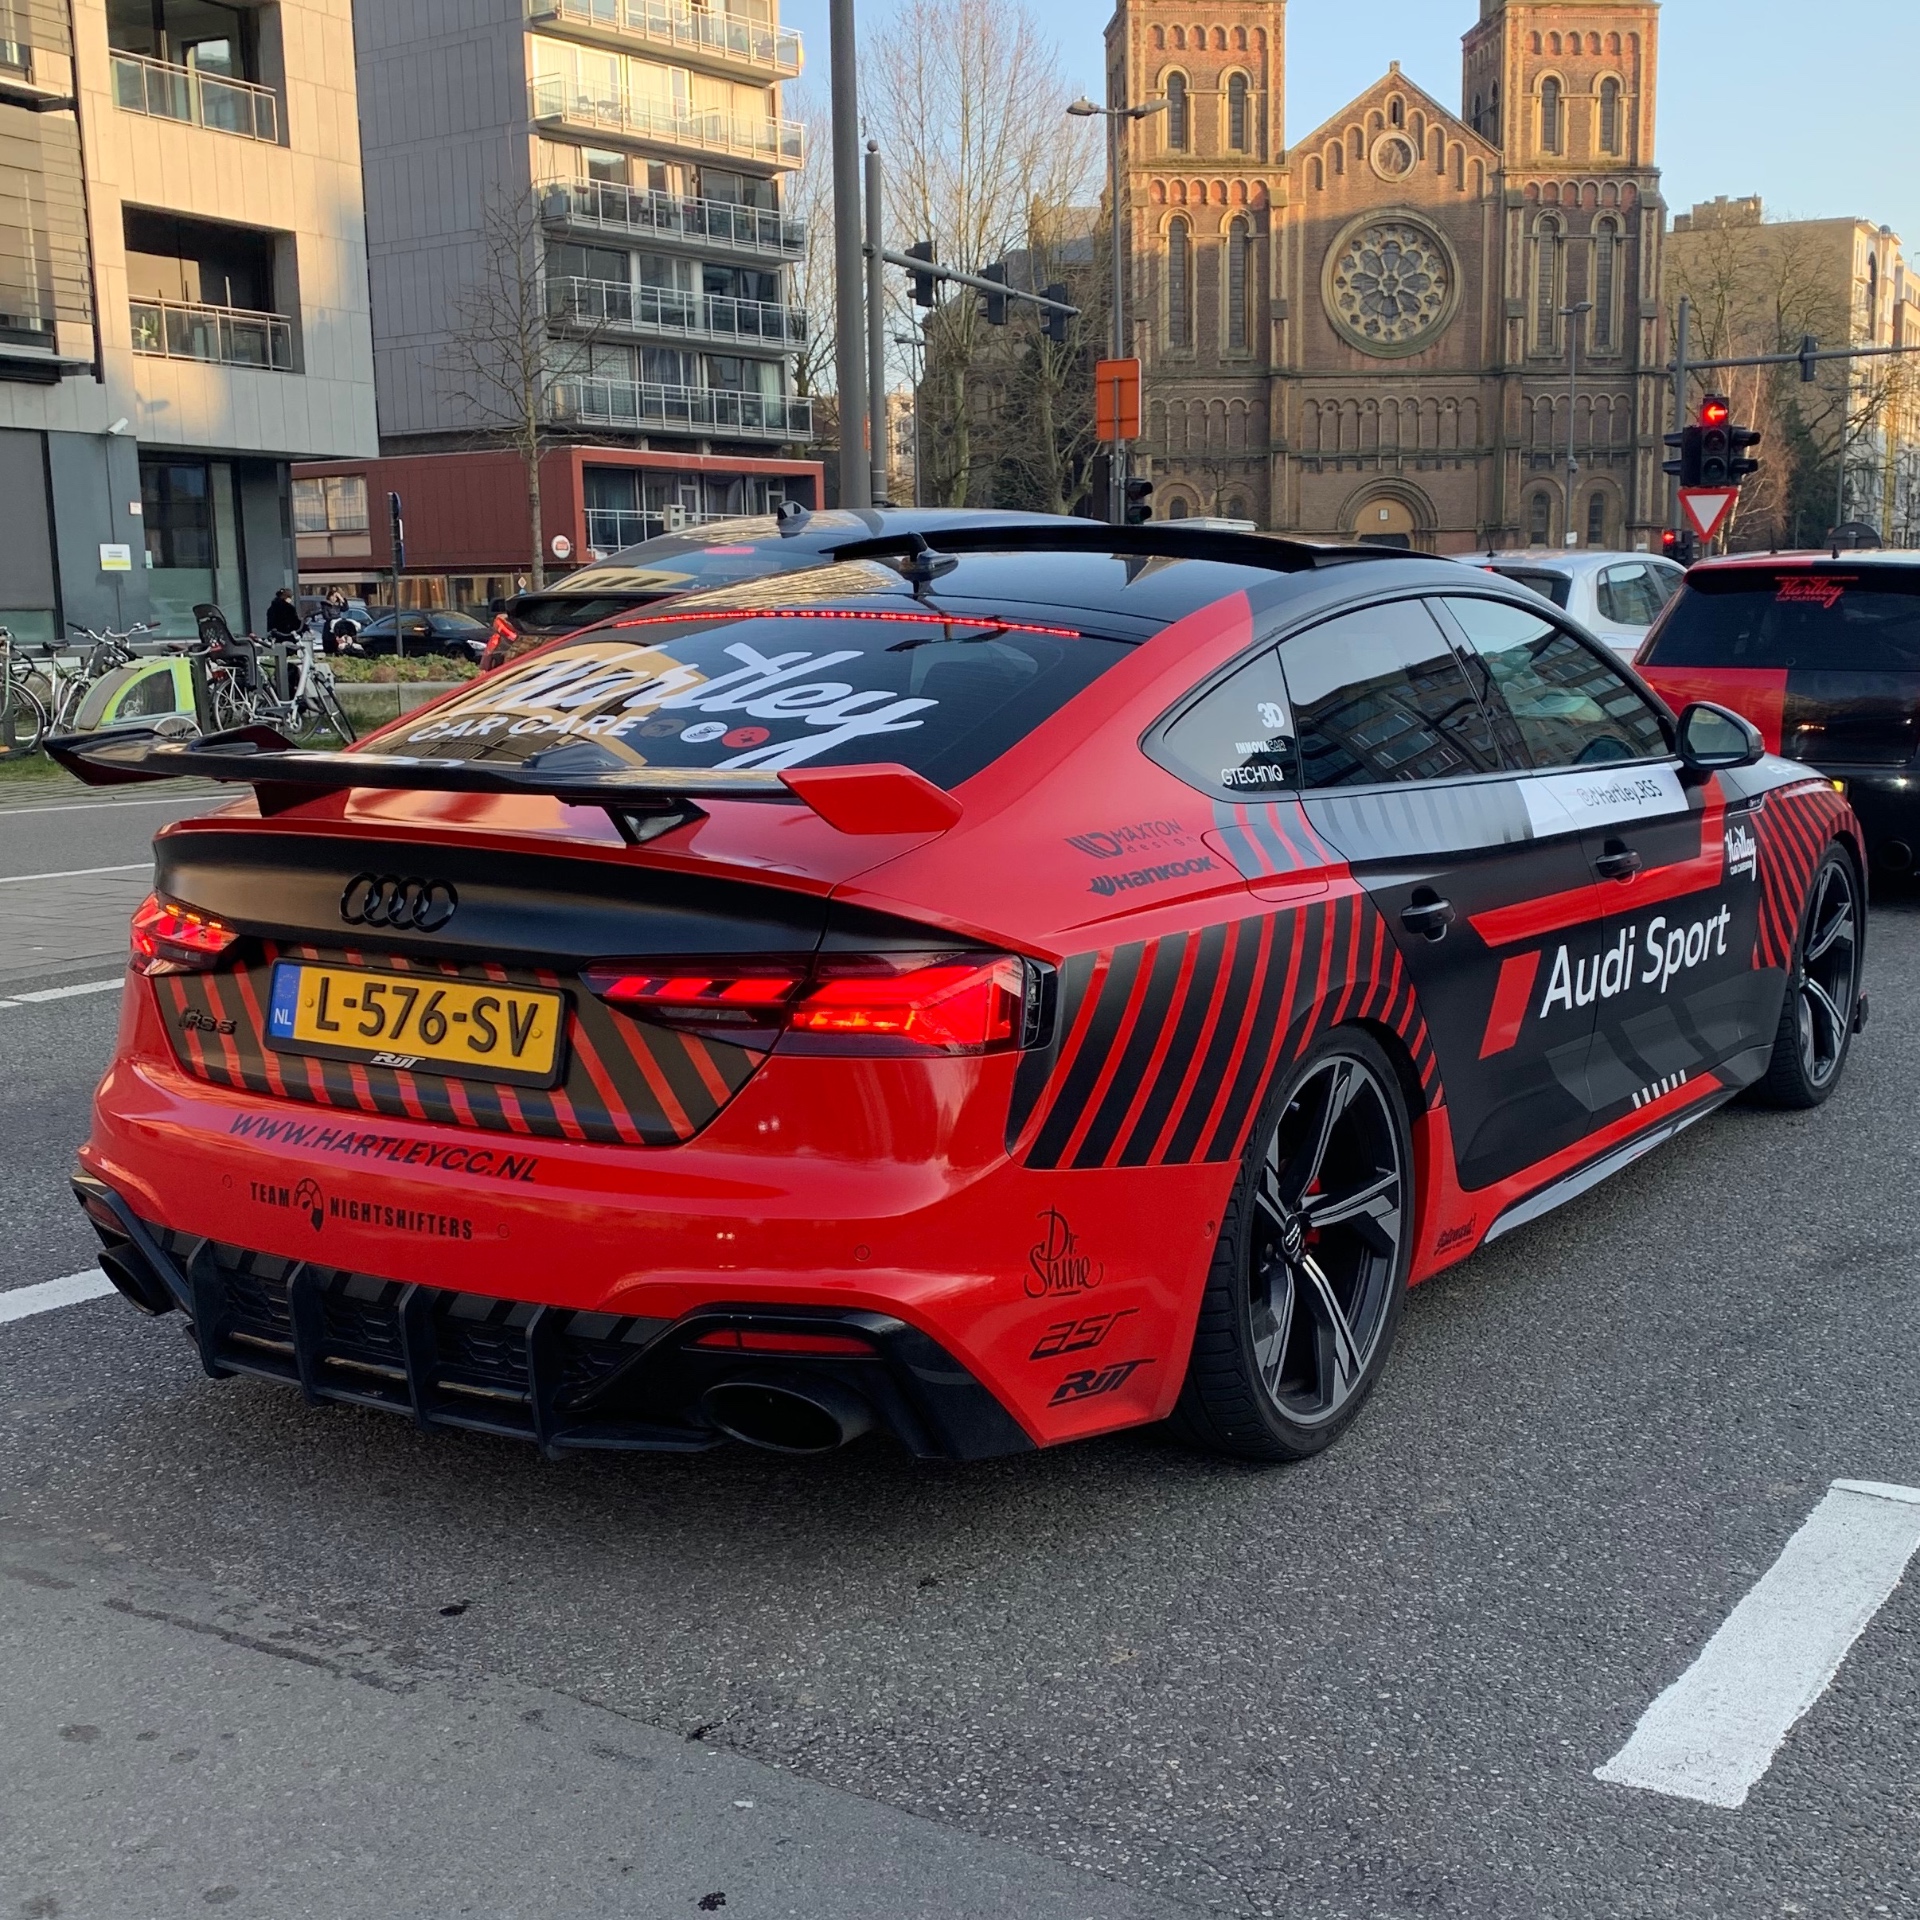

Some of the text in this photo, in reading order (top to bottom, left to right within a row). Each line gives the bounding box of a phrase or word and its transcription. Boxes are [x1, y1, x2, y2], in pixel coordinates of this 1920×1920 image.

[407, 713, 650, 743] CAR CARE
[1256, 702, 1285, 729] 3D
[1220, 764, 1285, 787] GTECHNIQ
[1109, 818, 1184, 844] MAXTON
[1126, 836, 1197, 853] design
[1539, 904, 1732, 1019] Audi Sport
[273, 1007, 292, 1026] NL
[315, 976, 539, 1058] L-576-SV
[229, 1112, 540, 1183] WWW.HARTLEYCC.NL
[250, 1181, 473, 1240] TEAM NIGHTSHIFTERS
[1023, 1240, 1104, 1299] Shine
